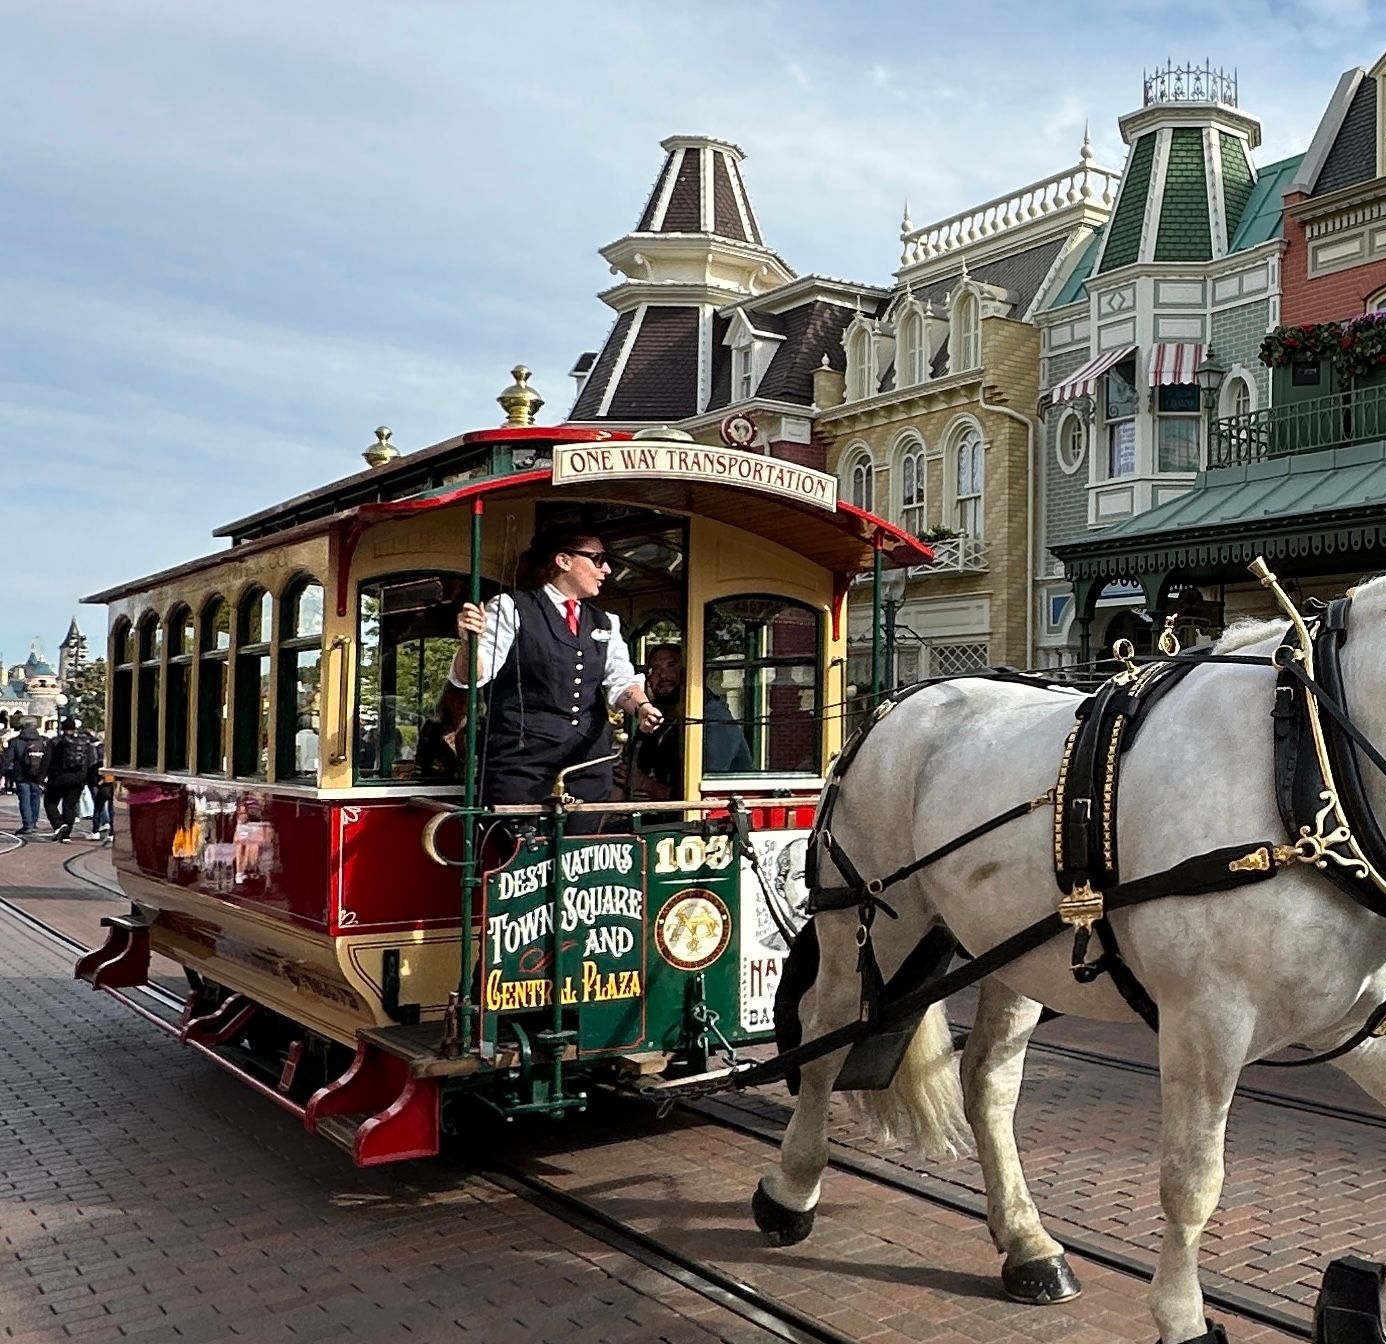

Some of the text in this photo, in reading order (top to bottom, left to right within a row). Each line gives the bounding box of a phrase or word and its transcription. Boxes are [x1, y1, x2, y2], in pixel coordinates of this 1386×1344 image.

[570, 445, 829, 499] ONE WAY TRANSPORTATION
[655, 834, 734, 874] 103
[486, 902, 555, 965] TOWN
[560, 884, 643, 932] SQUARE
[583, 925, 634, 958] AND
[581, 960, 641, 1003] PLAZA
